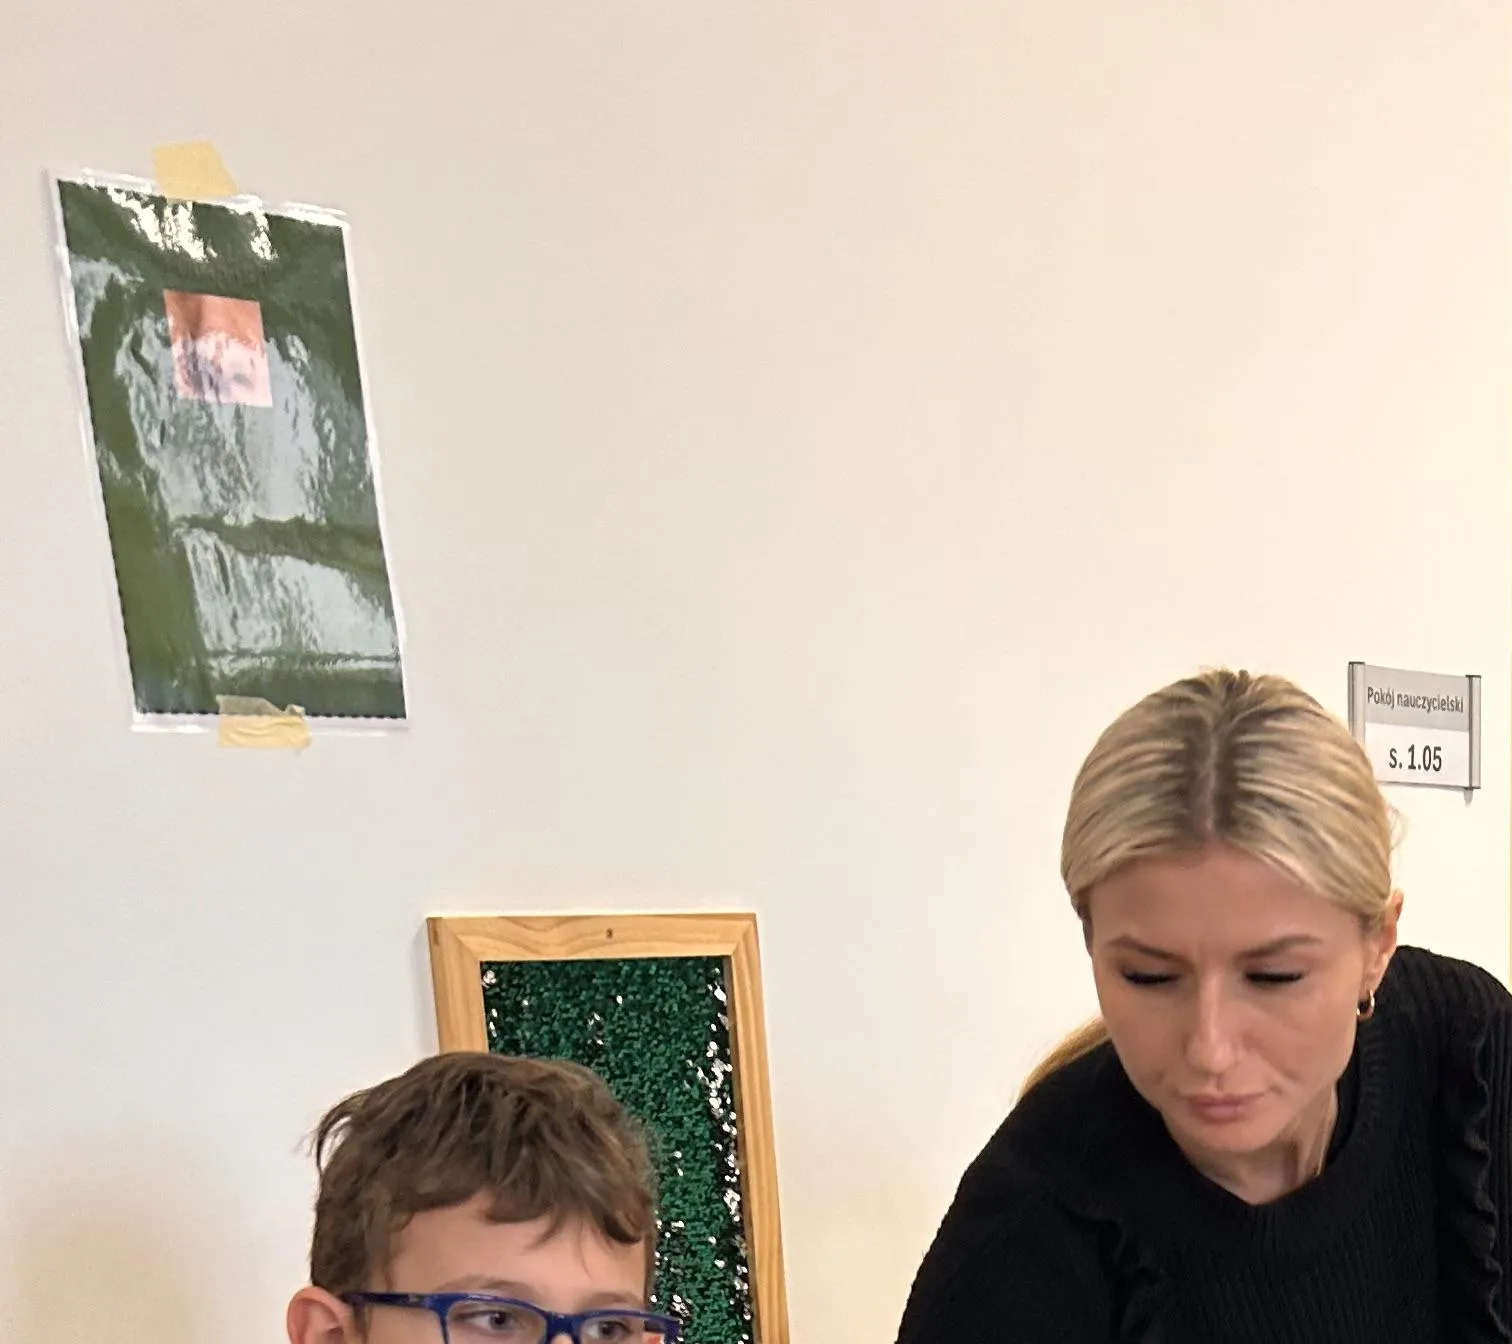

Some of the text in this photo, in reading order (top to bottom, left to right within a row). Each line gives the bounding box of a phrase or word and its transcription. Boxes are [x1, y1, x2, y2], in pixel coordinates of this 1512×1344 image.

[1367, 686, 1464, 713] Pokój nauczycielski
[1388, 744, 1442, 772] s. 1.05
